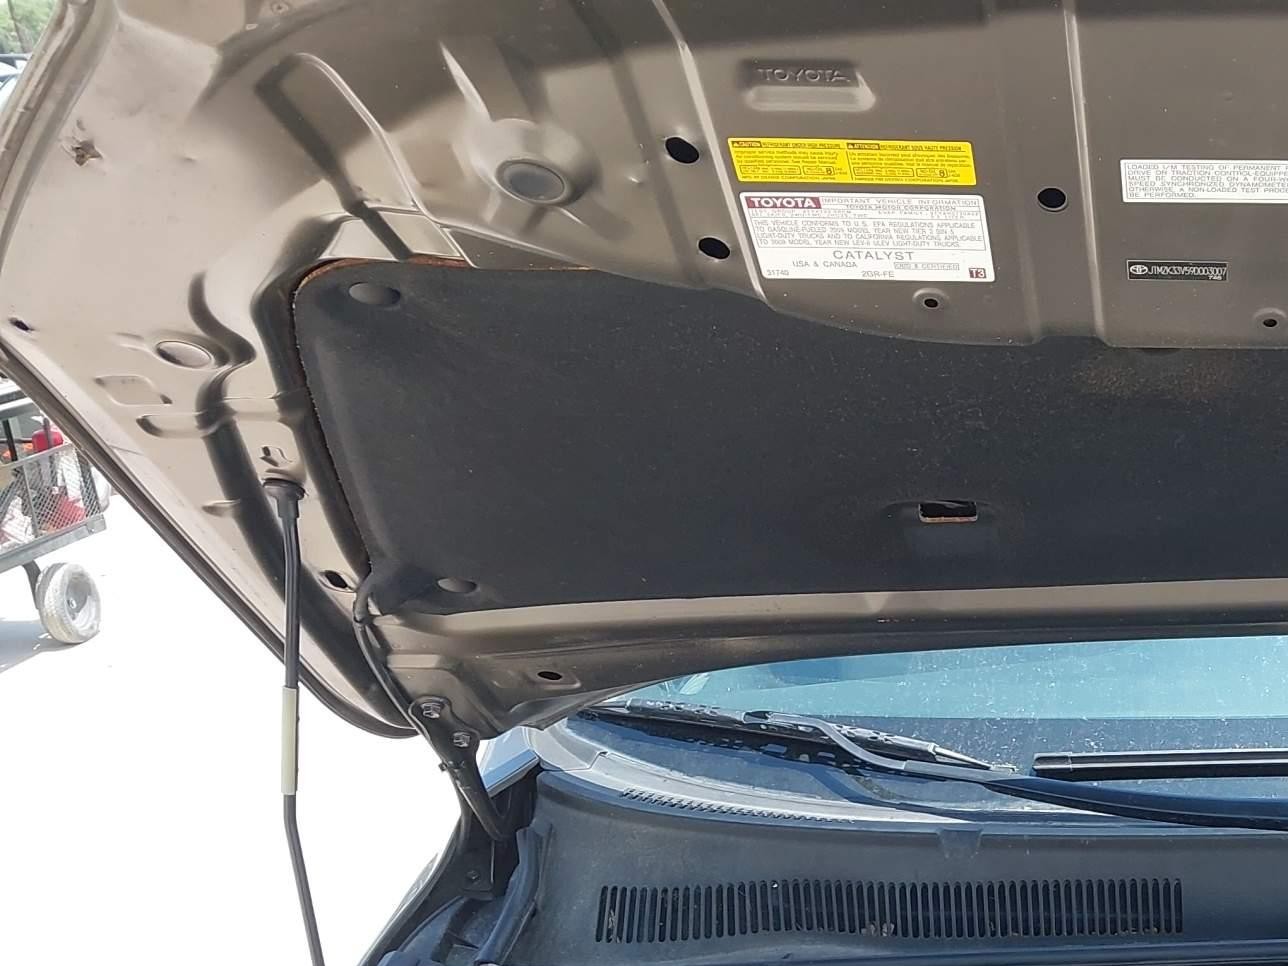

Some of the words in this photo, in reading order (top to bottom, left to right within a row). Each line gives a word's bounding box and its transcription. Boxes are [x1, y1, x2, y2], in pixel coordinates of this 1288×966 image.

[757, 67, 850, 82] TOYOTA
[750, 198, 817, 208] TOYOTA
[832, 250, 916, 261] CATALYST
[862, 270, 895, 278] 2GR-FE
[970, 269, 986, 278] T3
